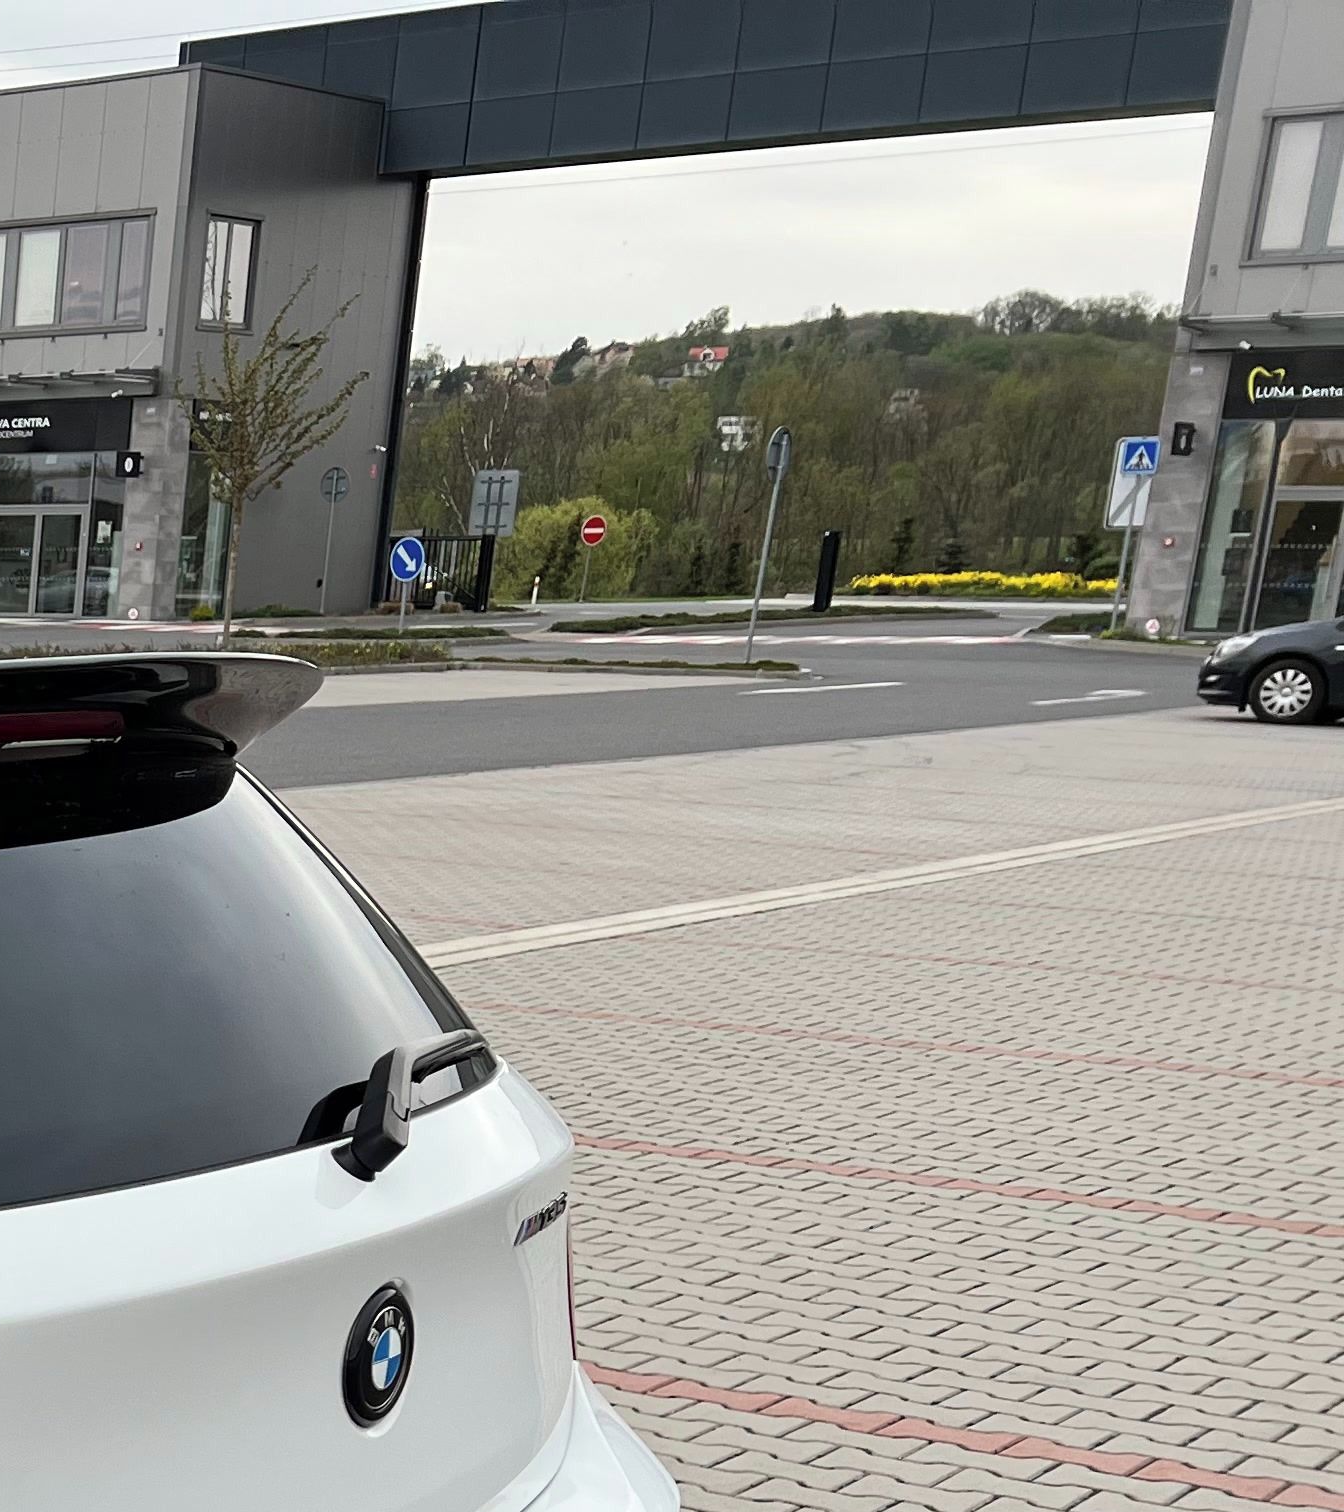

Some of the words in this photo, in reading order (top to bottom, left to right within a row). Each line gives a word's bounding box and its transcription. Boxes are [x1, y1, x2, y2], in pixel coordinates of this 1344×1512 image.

[1255, 386, 1294, 398] LUNA
[11, 417, 51, 428] CENTRA
[367, 1309, 406, 1347] BMW
